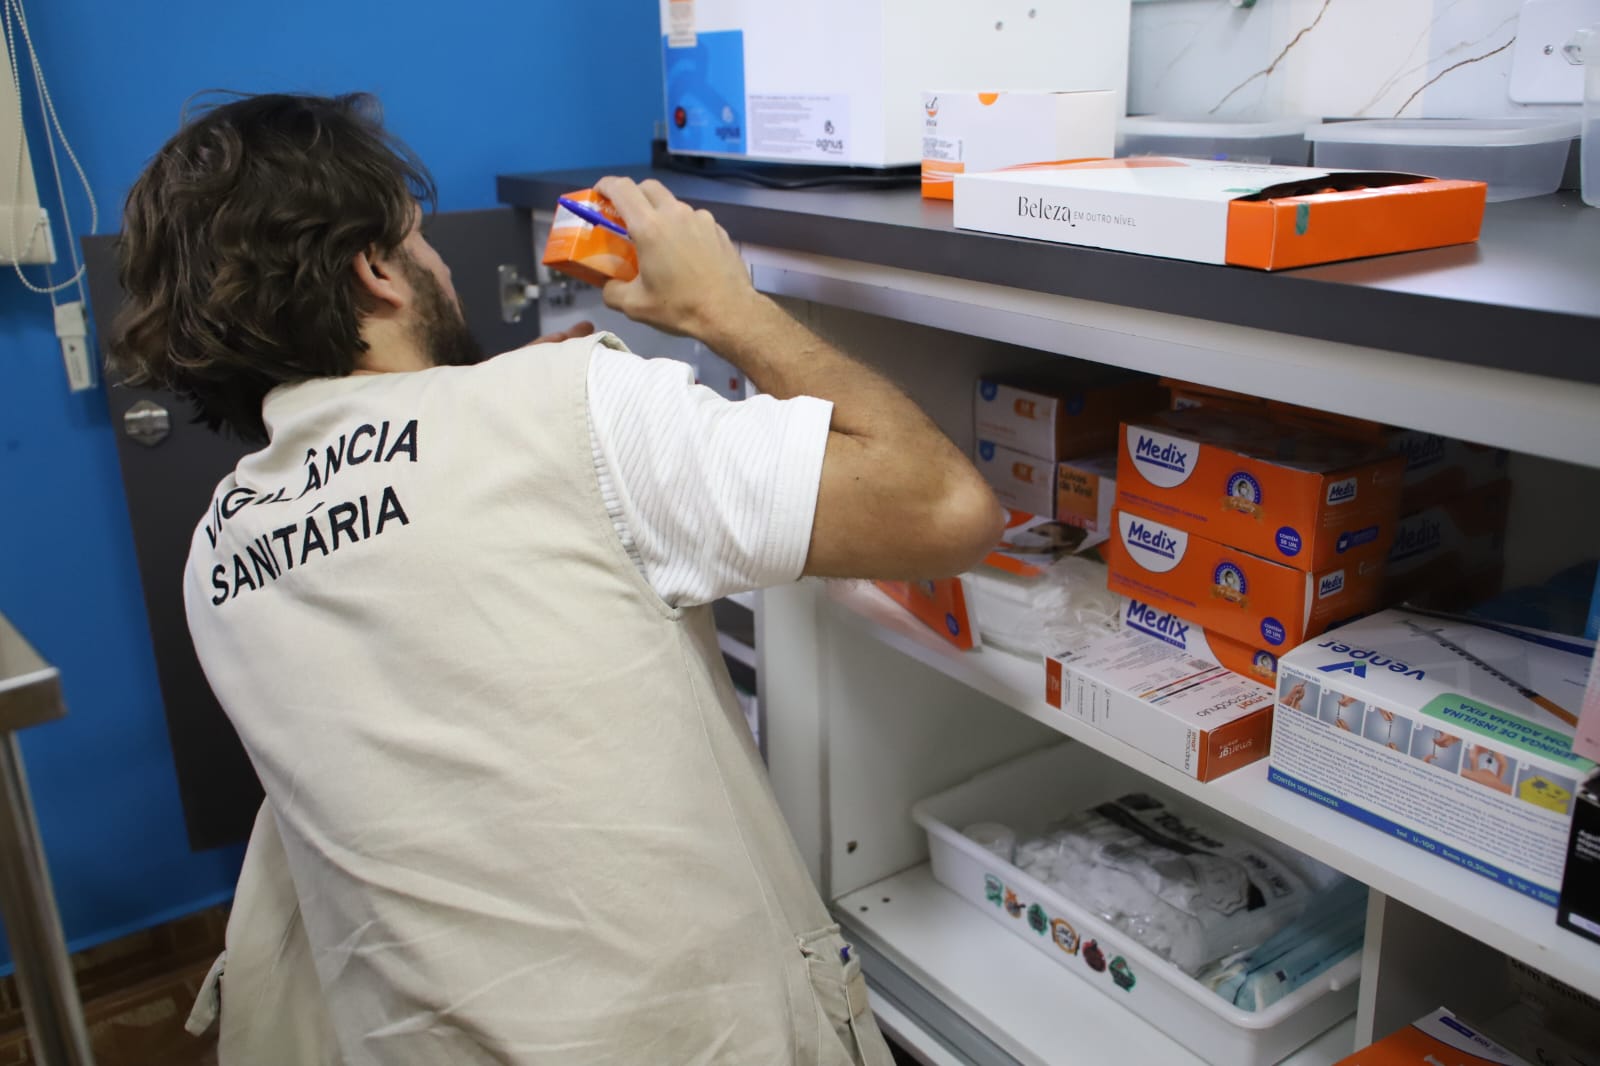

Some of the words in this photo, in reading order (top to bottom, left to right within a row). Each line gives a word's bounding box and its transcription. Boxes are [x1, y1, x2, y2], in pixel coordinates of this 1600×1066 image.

[816, 138, 843, 152] agnus
[1073, 211, 1085, 220] EM
[1086, 212, 1112, 224] OUTRO
[1113, 212, 1137, 227] NÍVEL
[1136, 435, 1187, 467] Medix
[206, 420, 418, 549] VIGILÂNCIA
[1329, 483, 1355, 499] Medix
[211, 486, 410, 606] SANITÁRIA
[1128, 521, 1176, 554] Medix
[1321, 575, 1343, 592] Medix
[1127, 599, 1189, 642] Medix
[1317, 641, 1425, 680] venper
[1442, 706, 1497, 732] INSULINA
[1460, 703, 1488, 717] FIXA
[1489, 714, 1542, 737] AGULHA
[1499, 727, 1518, 739] DE
[1272, 773, 1297, 789] CONTÉM
[1308, 788, 1339, 807] UNIDADES
